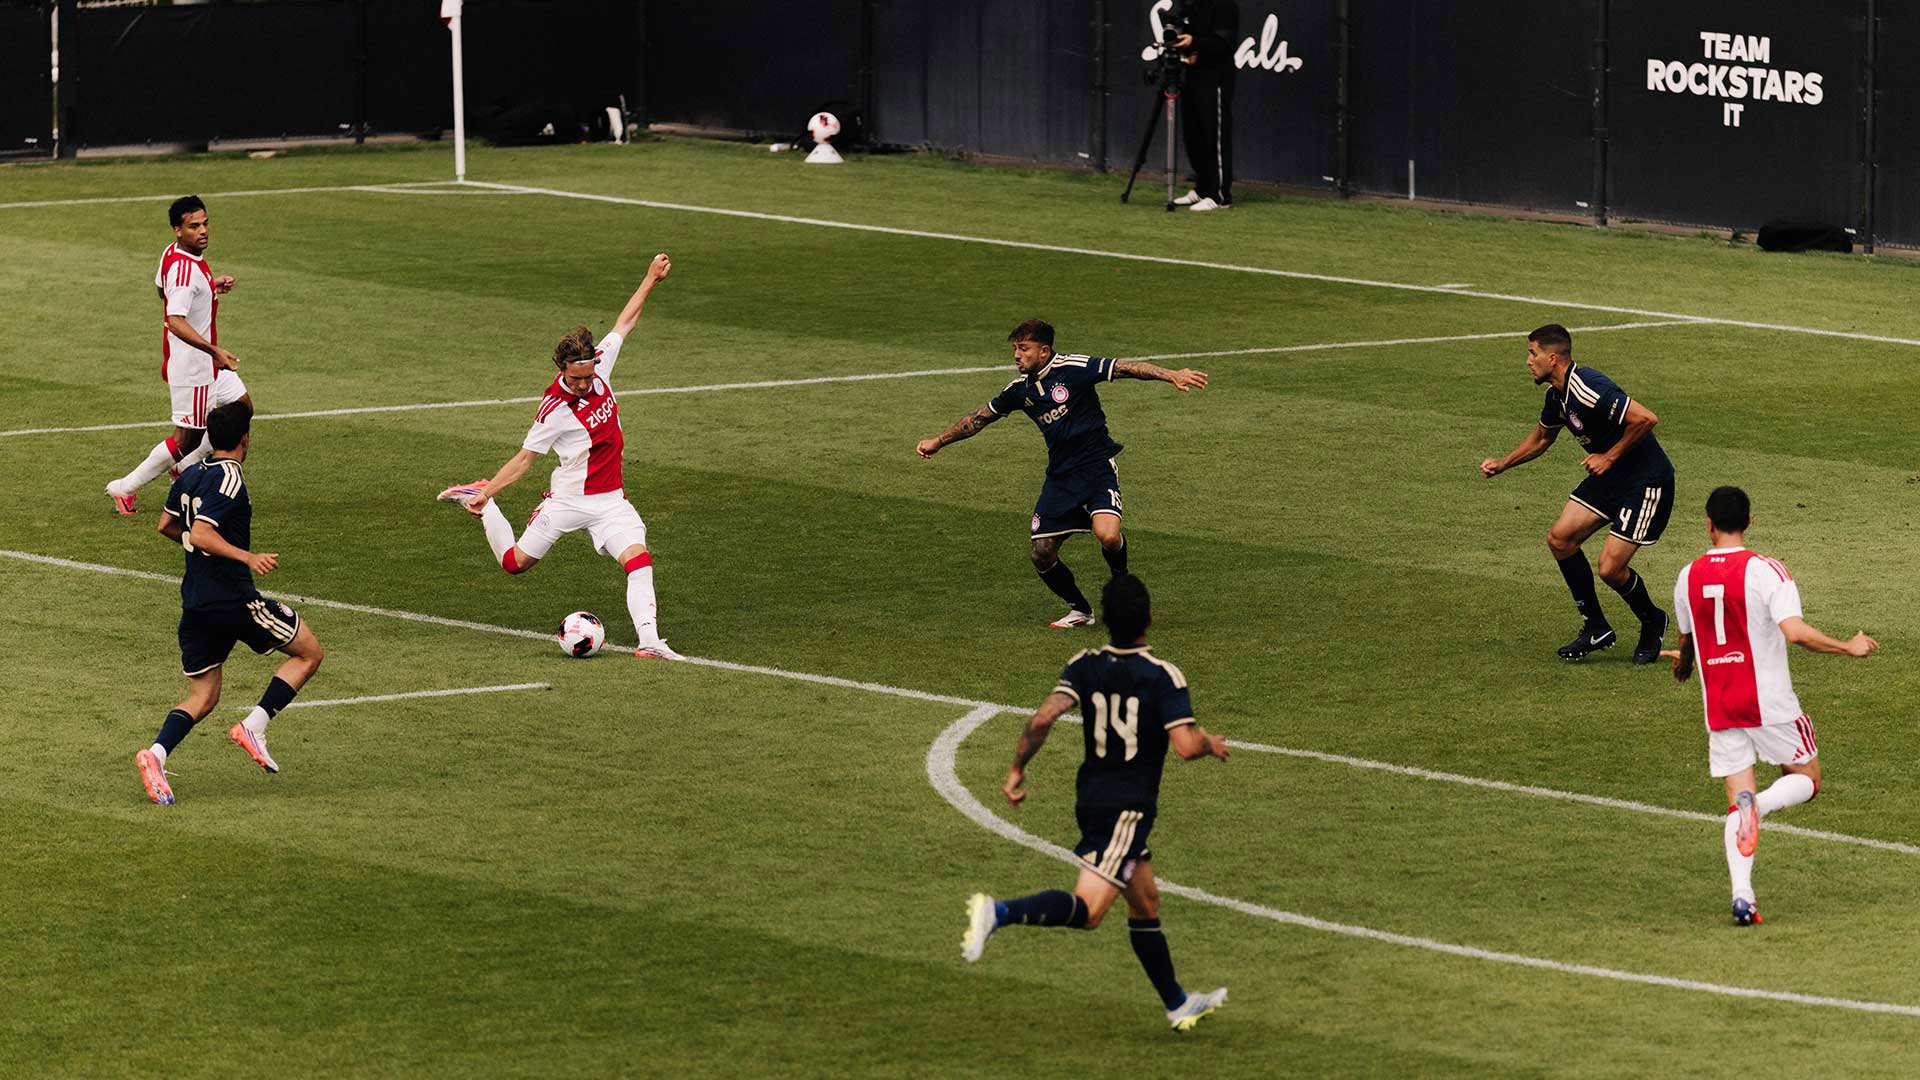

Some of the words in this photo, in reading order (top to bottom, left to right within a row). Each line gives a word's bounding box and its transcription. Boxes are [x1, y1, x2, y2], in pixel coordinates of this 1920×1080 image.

[1700, 31, 1771, 64] TEAM
[1646, 59, 1824, 105] ROCKSTARS
[1723, 102, 1744, 127] IT
[586, 396, 614, 429] ziggo
[1107, 488, 1123, 510] 15
[1619, 507, 1632, 532] 4
[1702, 584, 1727, 646] 7
[1706, 652, 1745, 666] OLYMPIA
[1091, 691, 1140, 762] 14
